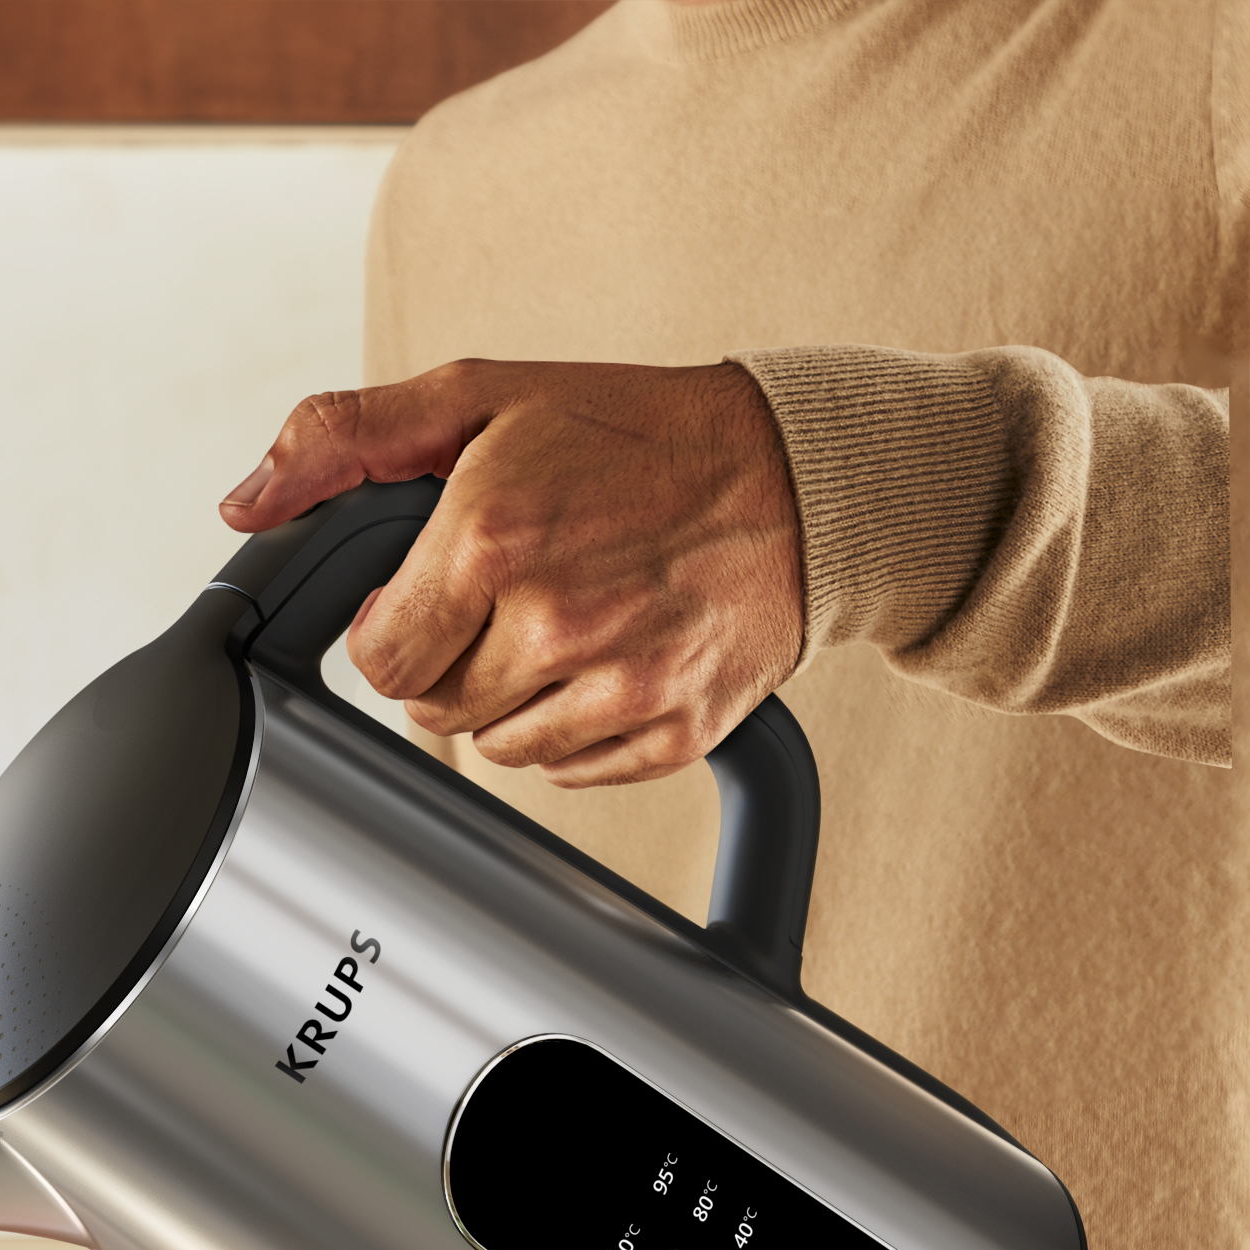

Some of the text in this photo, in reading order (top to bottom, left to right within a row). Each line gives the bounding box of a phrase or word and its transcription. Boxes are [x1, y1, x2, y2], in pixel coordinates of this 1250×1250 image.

[275, 929, 381, 1084] KRUPS
[652, 1152, 678, 1195] 95°C
[692, 1179, 718, 1222] 80°C
[734, 1206, 757, 1249] 40°C
